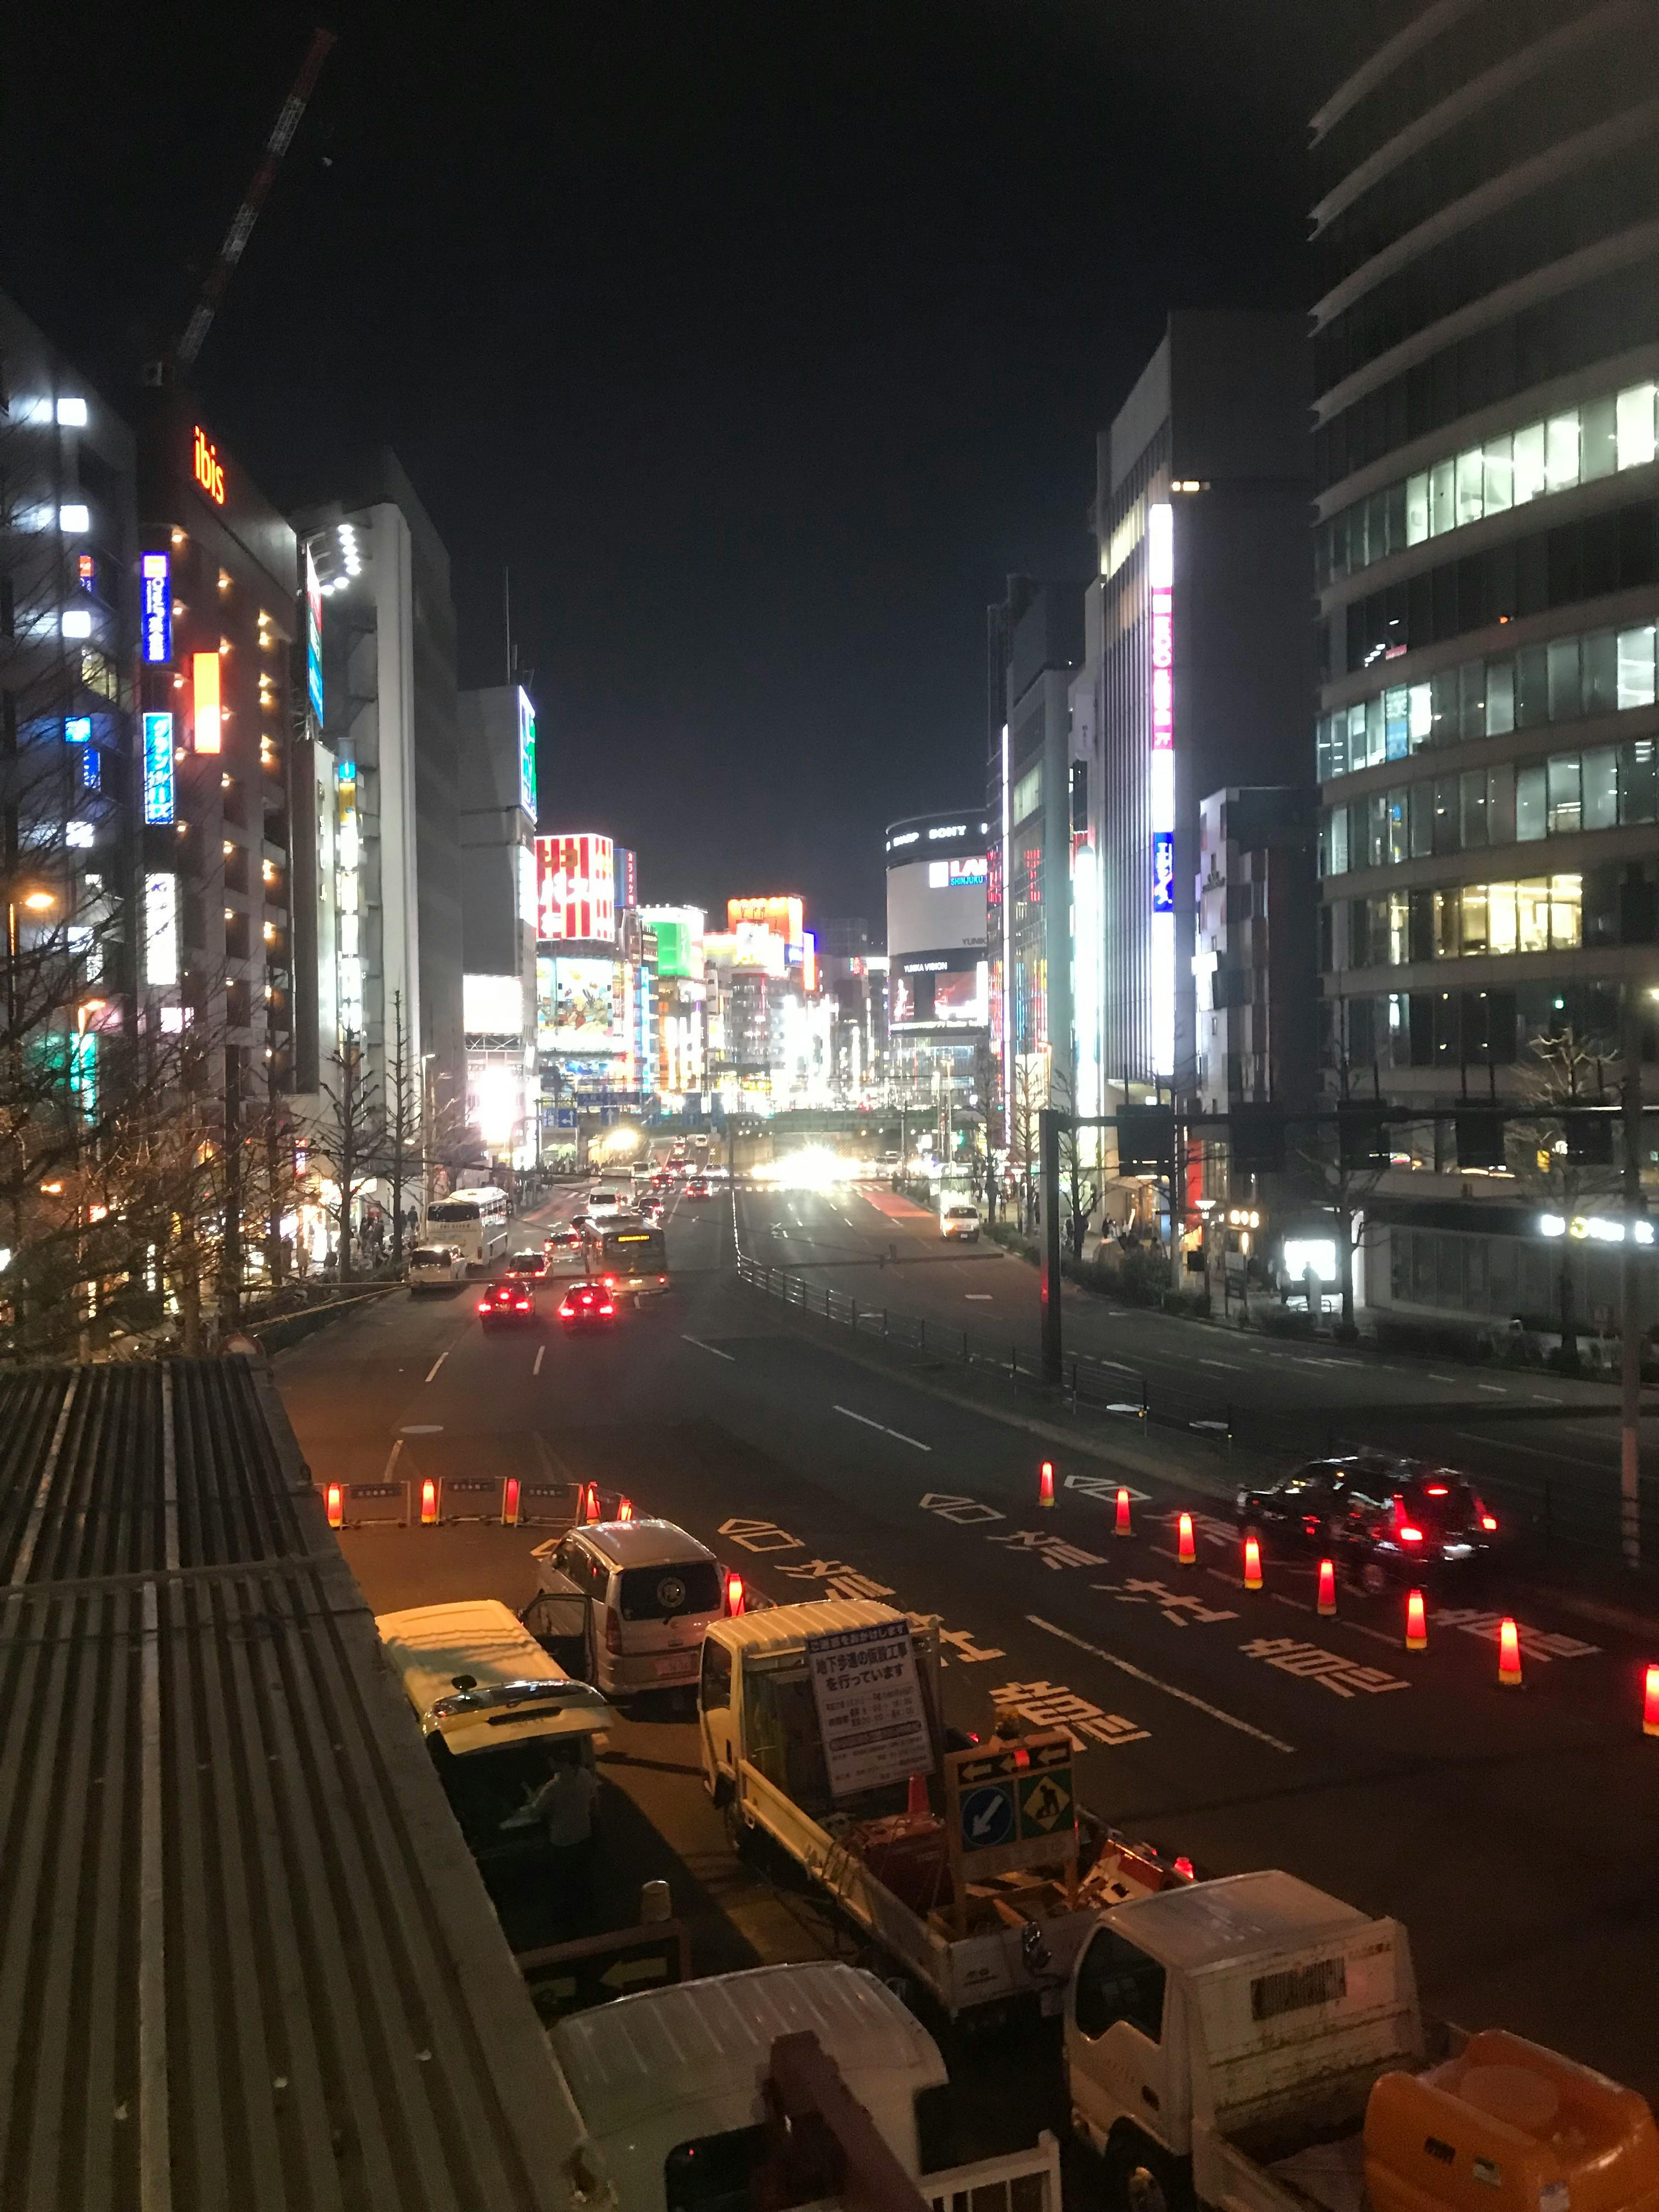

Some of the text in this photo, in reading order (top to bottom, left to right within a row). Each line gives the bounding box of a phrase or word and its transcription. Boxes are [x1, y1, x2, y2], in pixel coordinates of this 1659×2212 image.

[194, 426, 225, 505] ibis
[929, 825, 967, 839] SONY
[951, 876, 983, 886] SHINJUKU
[904, 962, 948, 973] YUNIKA VISION
